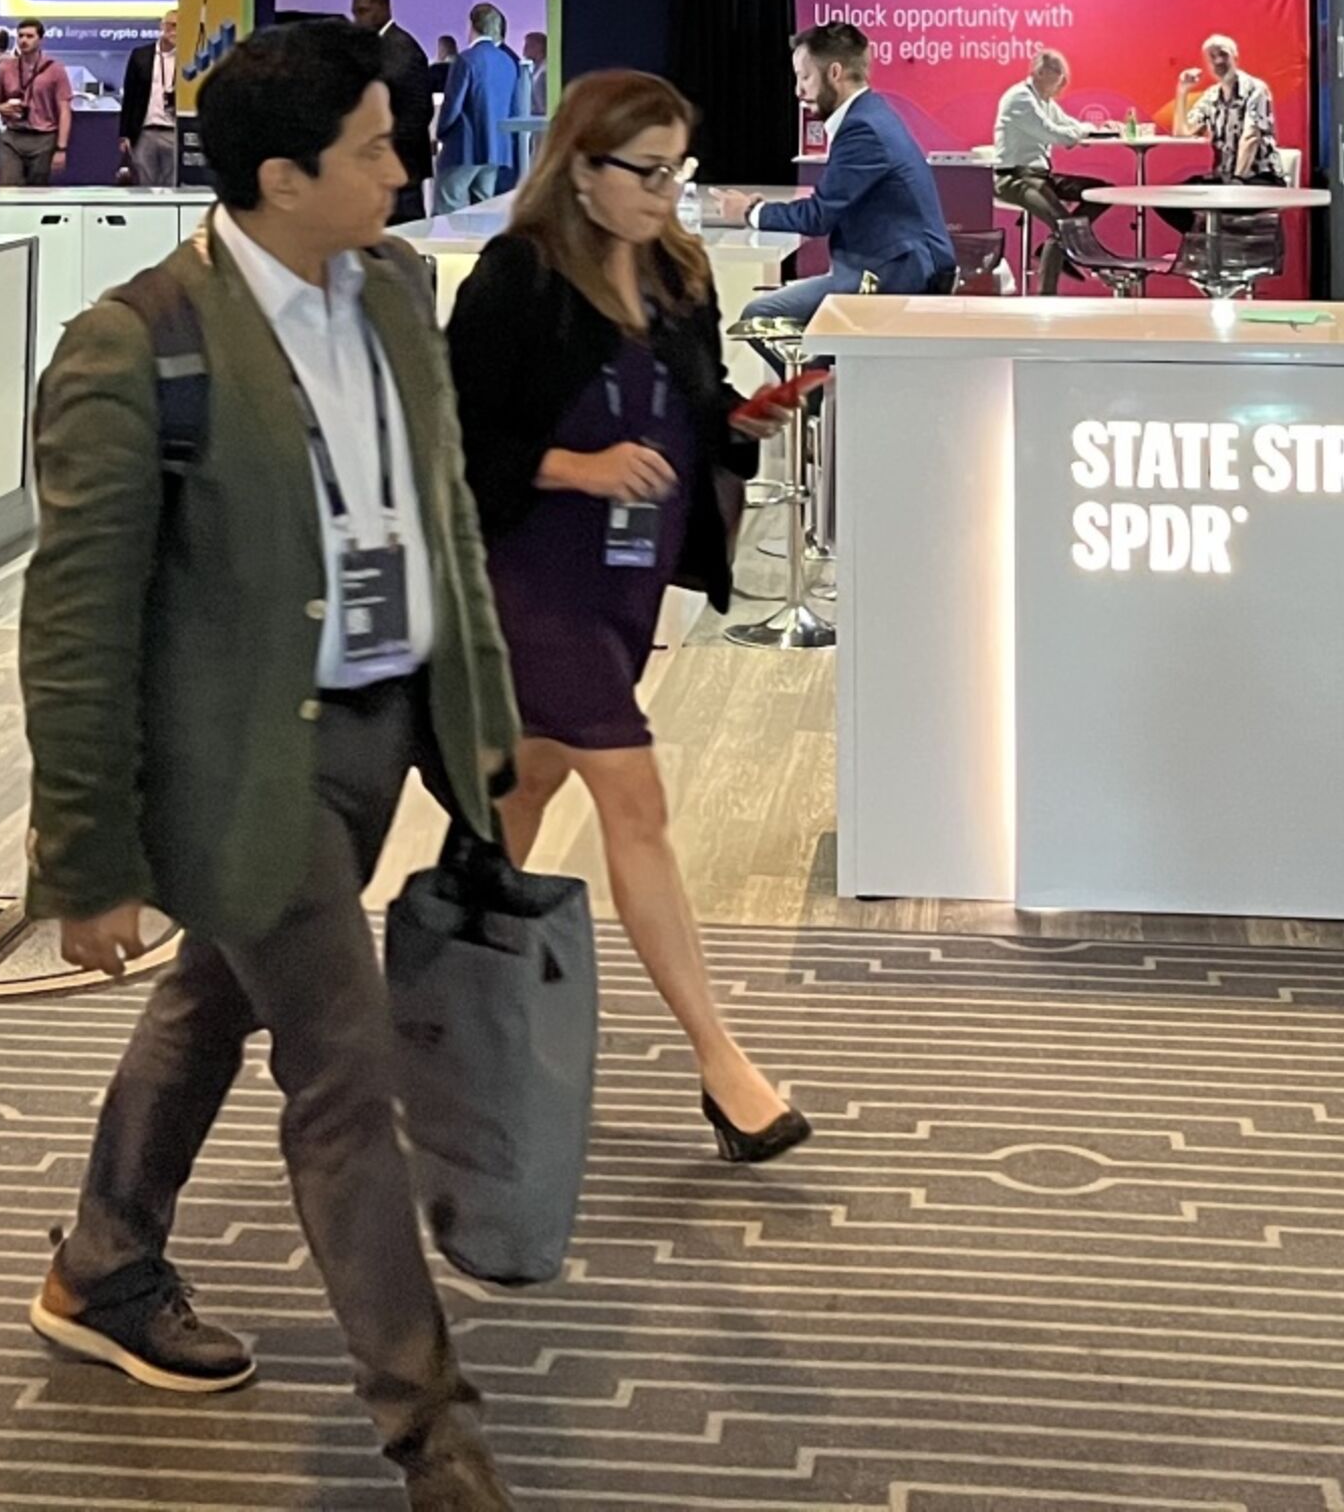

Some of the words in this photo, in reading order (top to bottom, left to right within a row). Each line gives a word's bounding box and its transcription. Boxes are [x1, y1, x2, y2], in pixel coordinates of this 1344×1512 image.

[814, 4, 887, 27] Unlock
[893, 4, 1018, 31] opportunity
[1025, 4, 1073, 27] with
[99, 27, 139, 41] crypto
[899, 36, 953, 66] edge
[960, 36, 1044, 66] insights
[1070, 420, 1240, 491] STATE
